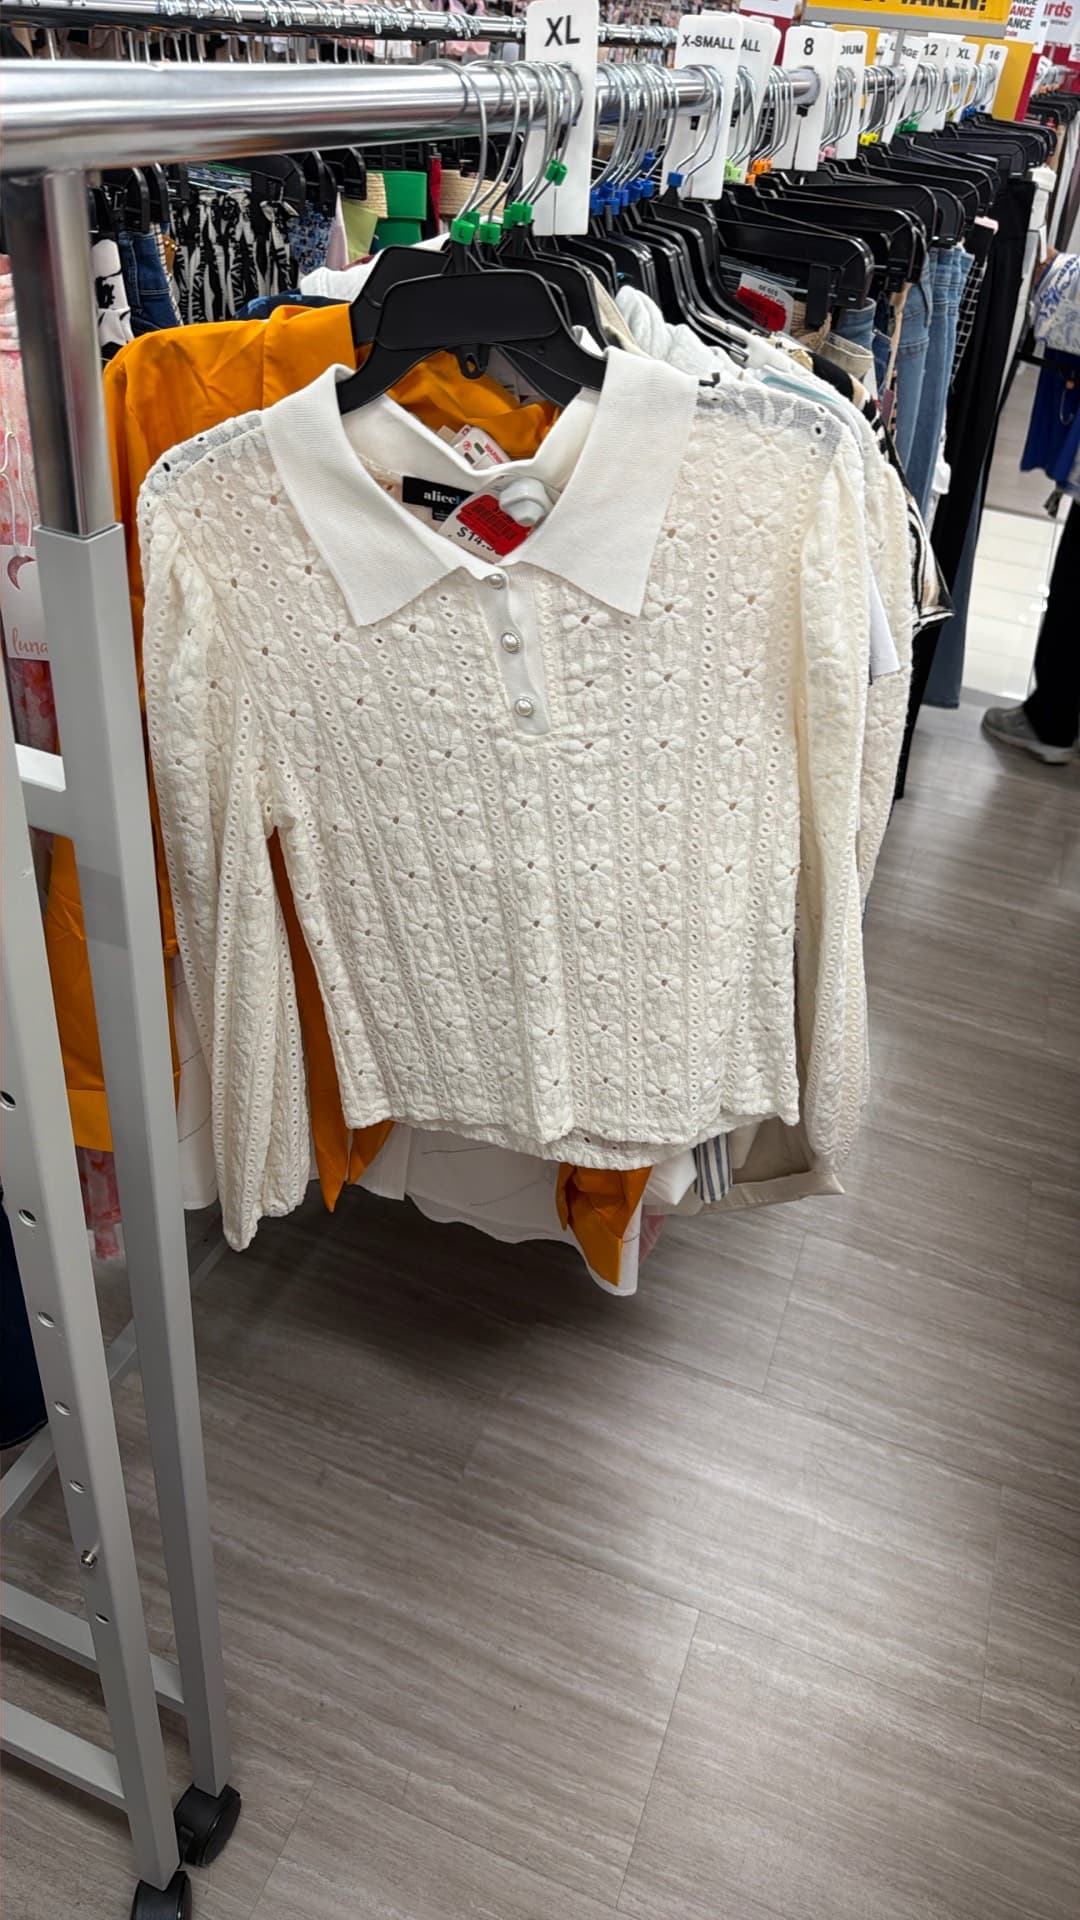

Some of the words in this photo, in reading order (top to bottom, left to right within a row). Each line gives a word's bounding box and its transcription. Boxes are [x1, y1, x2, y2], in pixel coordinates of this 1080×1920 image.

[544, 15, 581, 47] XL
[682, 35, 735, 50] X-SMALL
[803, 37, 814, 55] 8
[890, 42, 919, 59] LRGE
[923, 44, 938, 56] 12
[956, 47, 971, 60] XL
[457, 526, 498, 552] $14.
[12, 627, 48, 655] luna
